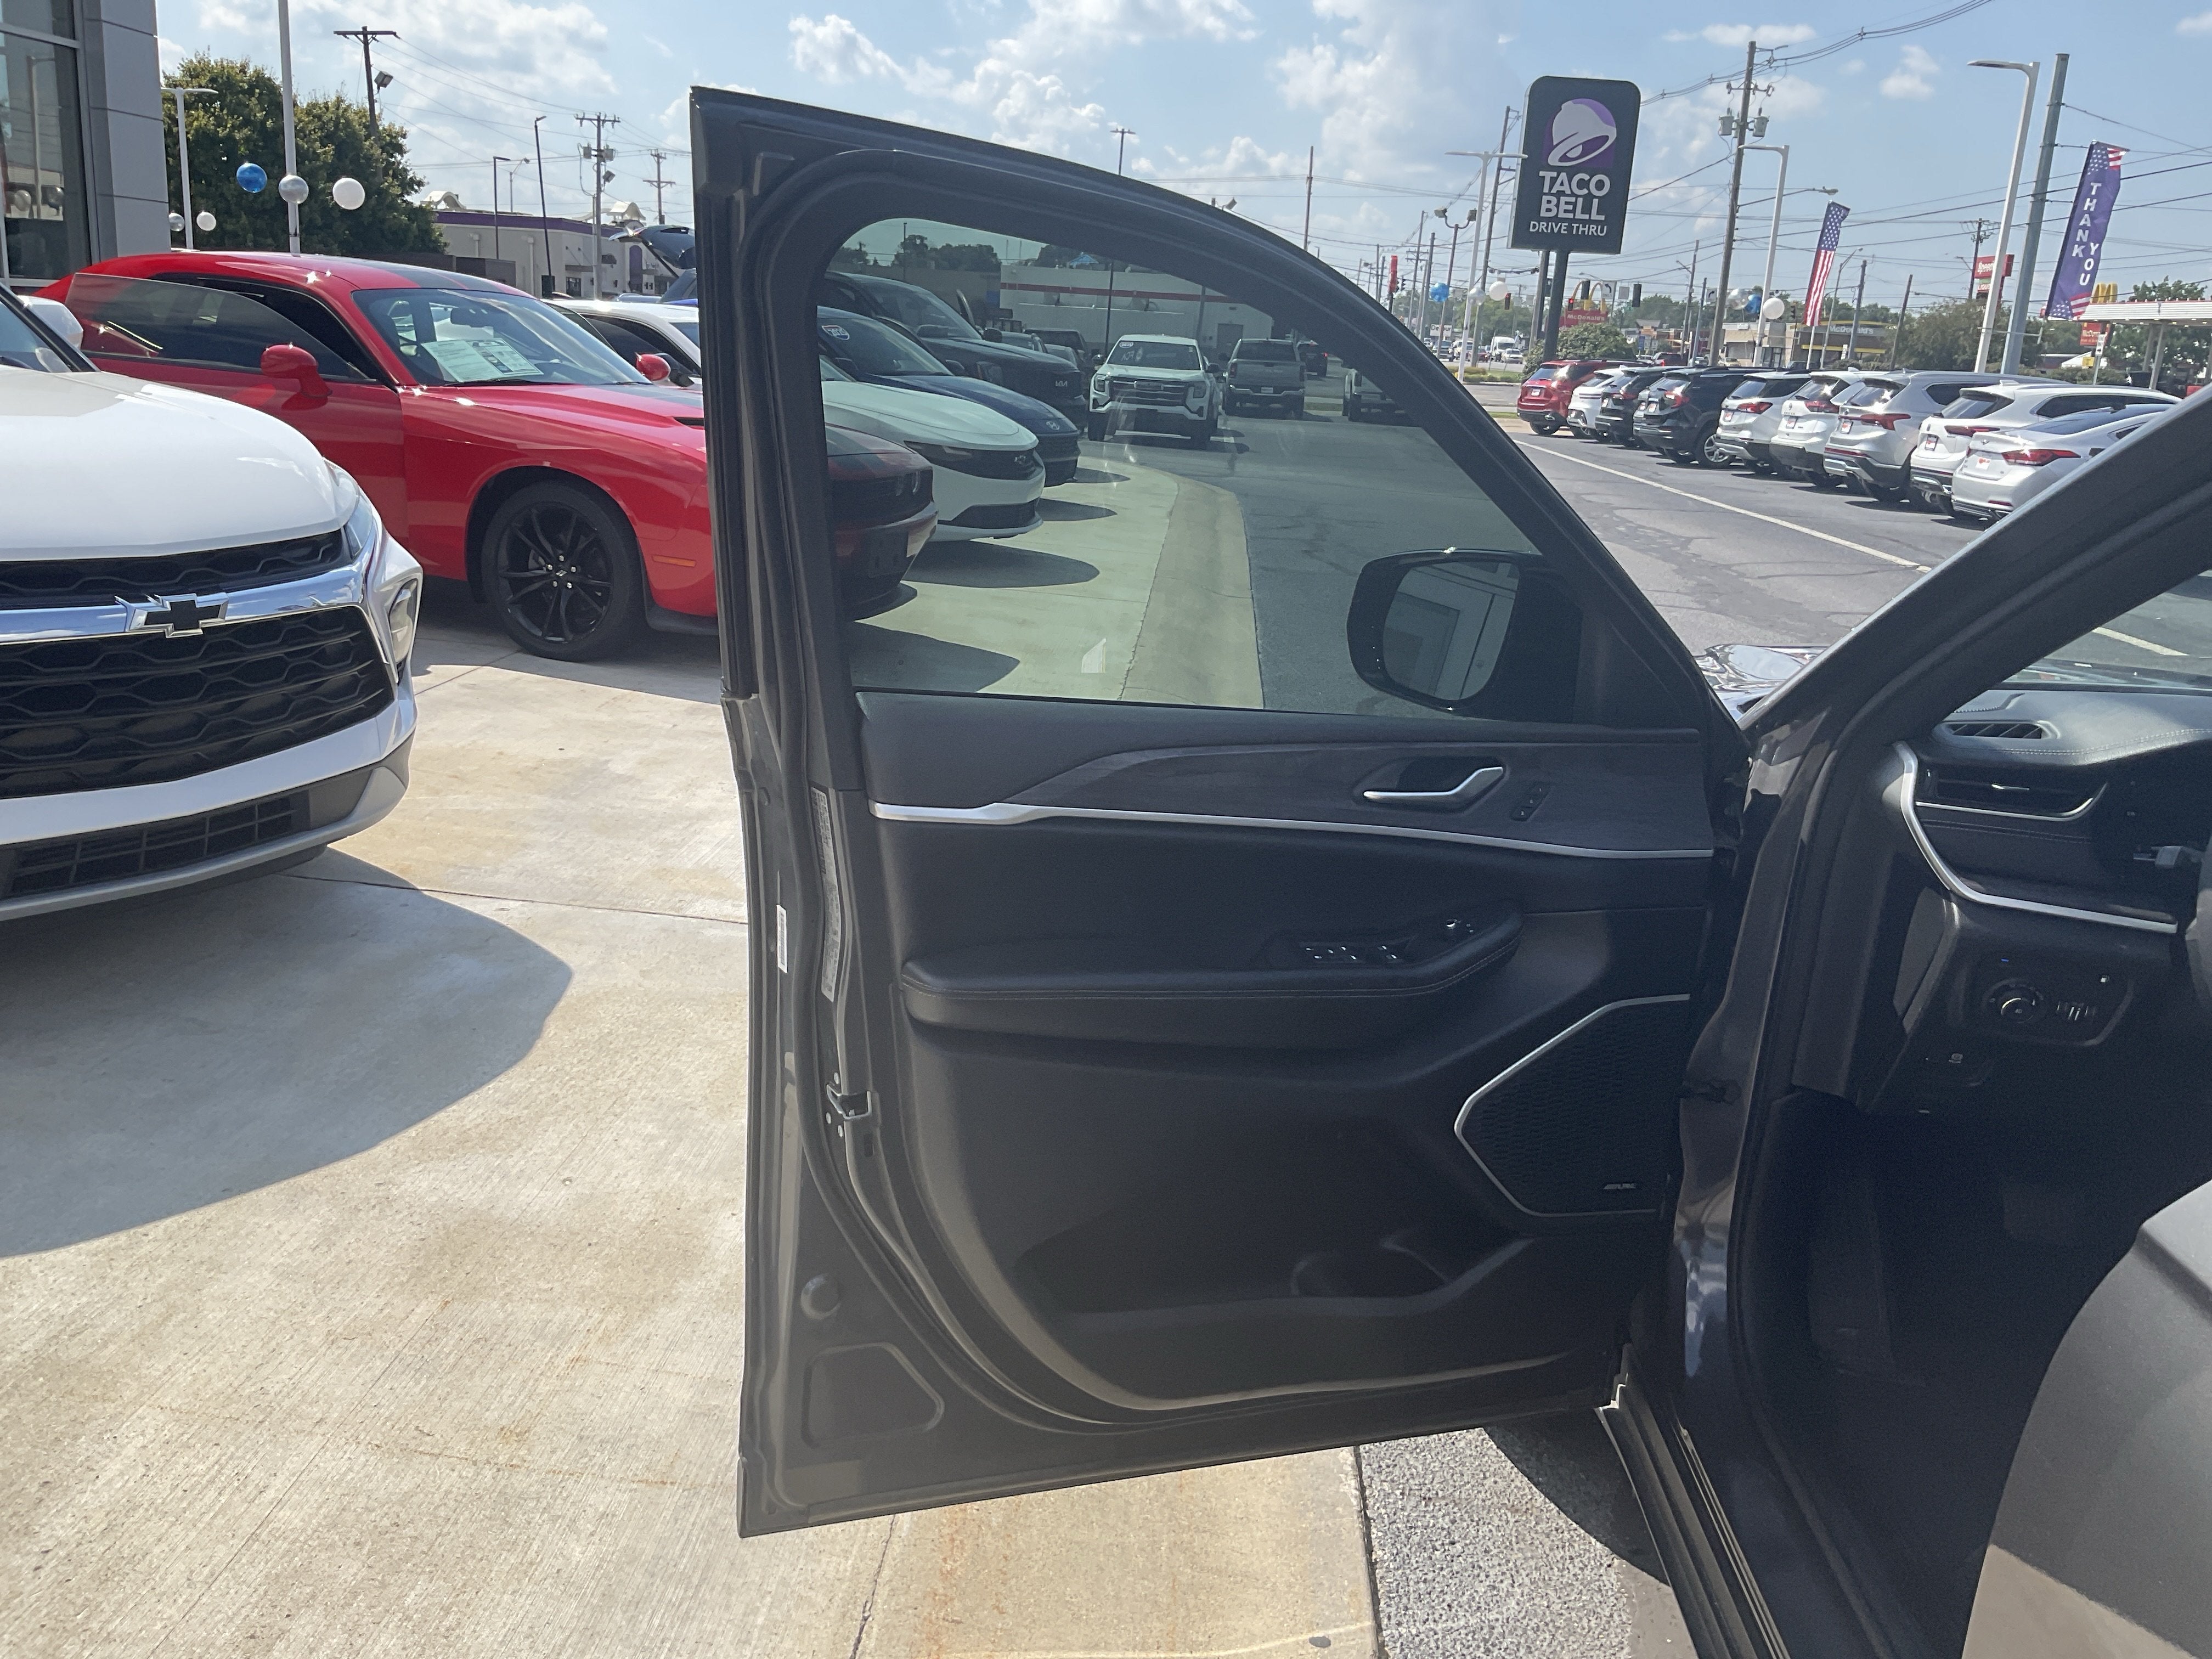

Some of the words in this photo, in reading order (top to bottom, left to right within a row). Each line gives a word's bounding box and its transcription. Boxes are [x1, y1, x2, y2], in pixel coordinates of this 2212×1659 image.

[1539, 171, 1611, 197] TACO
[1539, 195, 1605, 221] BELL
[2072, 182, 2102, 258] THANK
[1529, 221, 1568, 234] DRIVE
[1571, 223, 1607, 236] THRU
[1977, 261, 1995, 275] Speed
[2079, 242, 2100, 286] YOU
